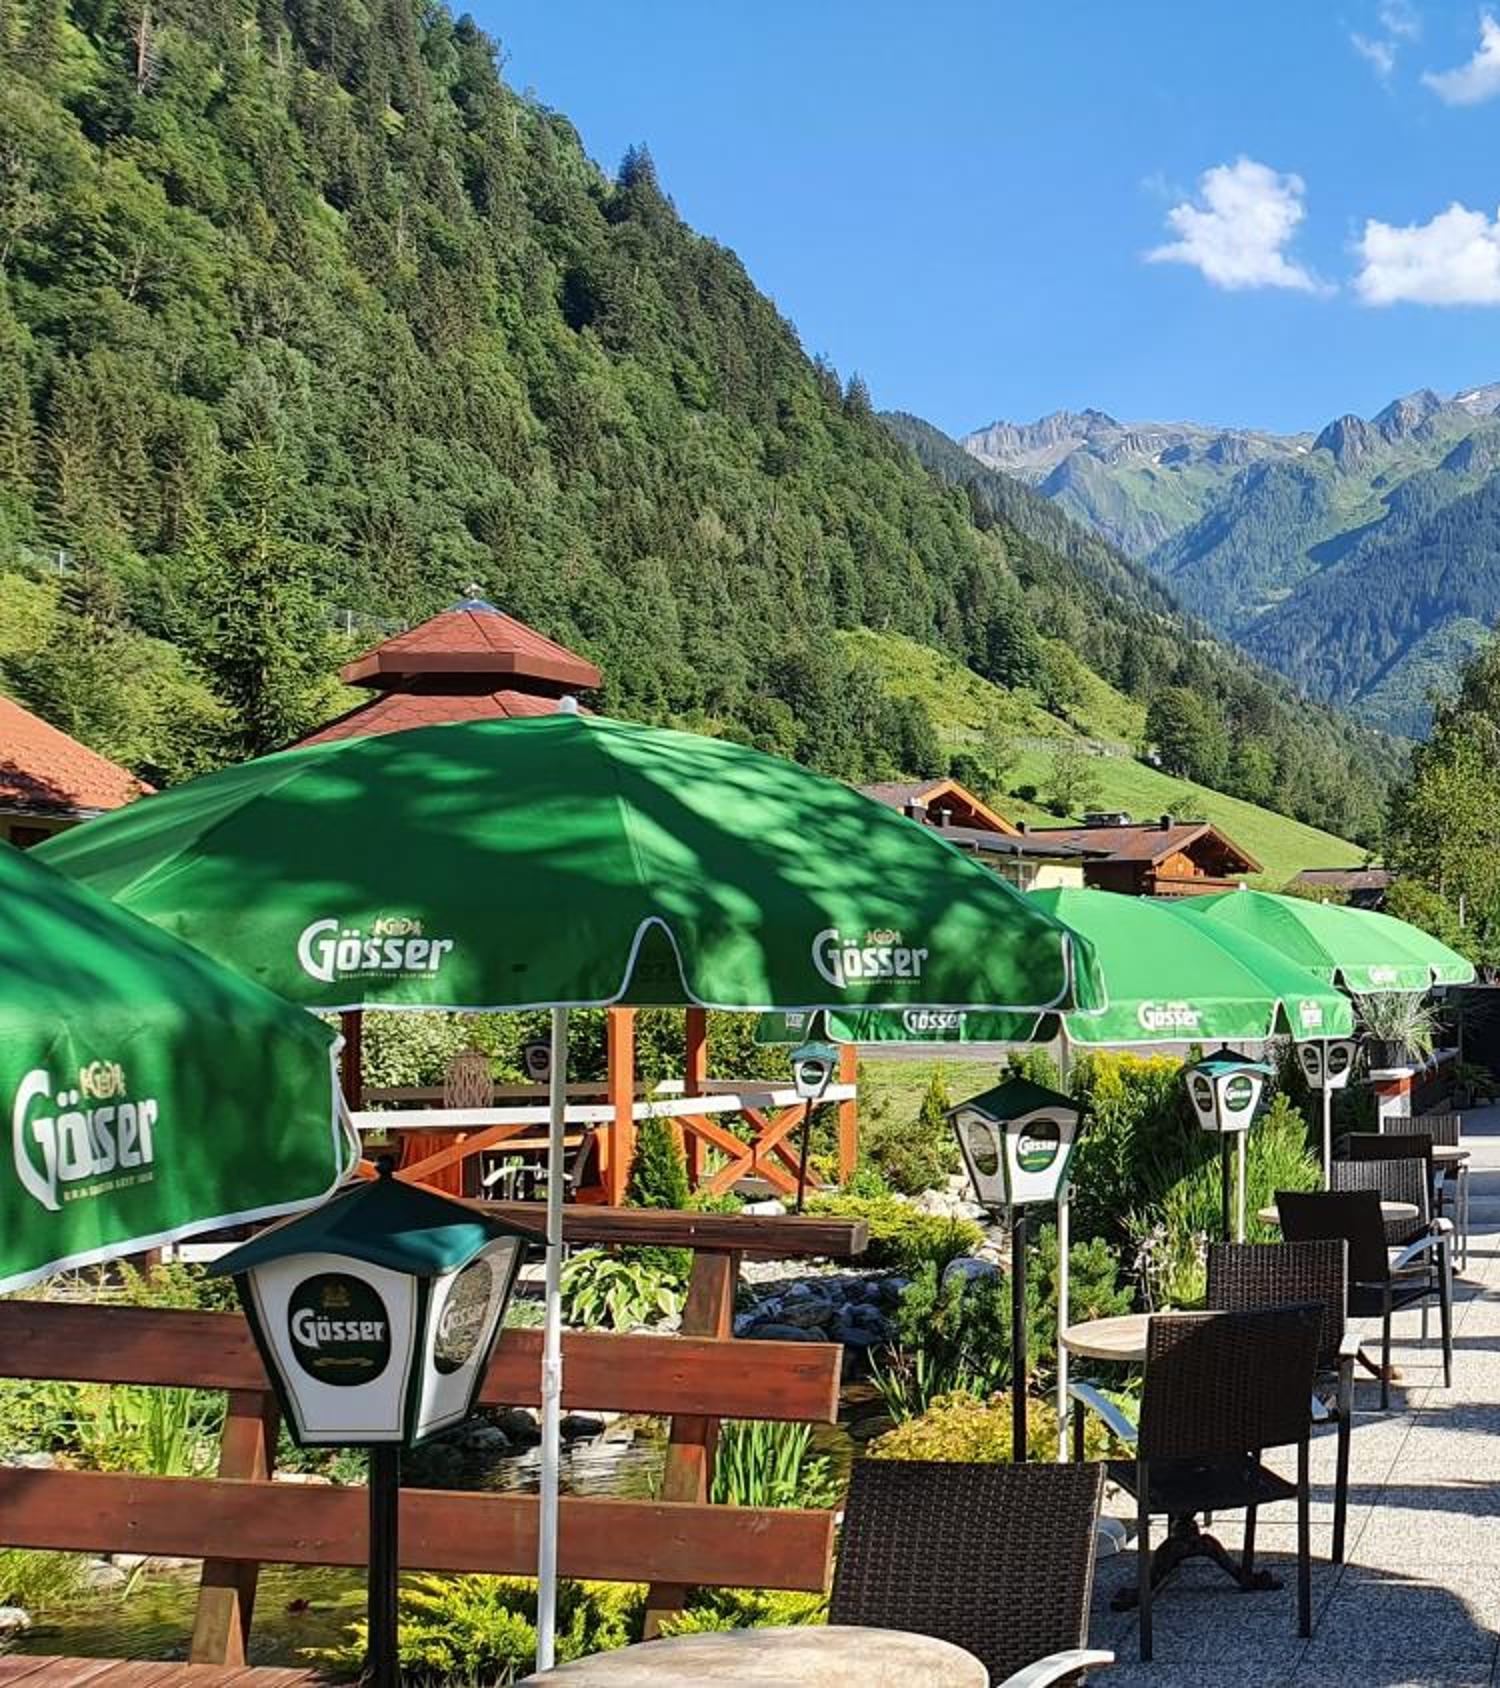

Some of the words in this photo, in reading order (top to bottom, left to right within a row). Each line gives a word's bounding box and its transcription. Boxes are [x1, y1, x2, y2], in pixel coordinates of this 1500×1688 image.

[297, 918, 454, 982] Gösser
[811, 928, 929, 989] Gösser
[291, 1307, 385, 1349] Gösser
